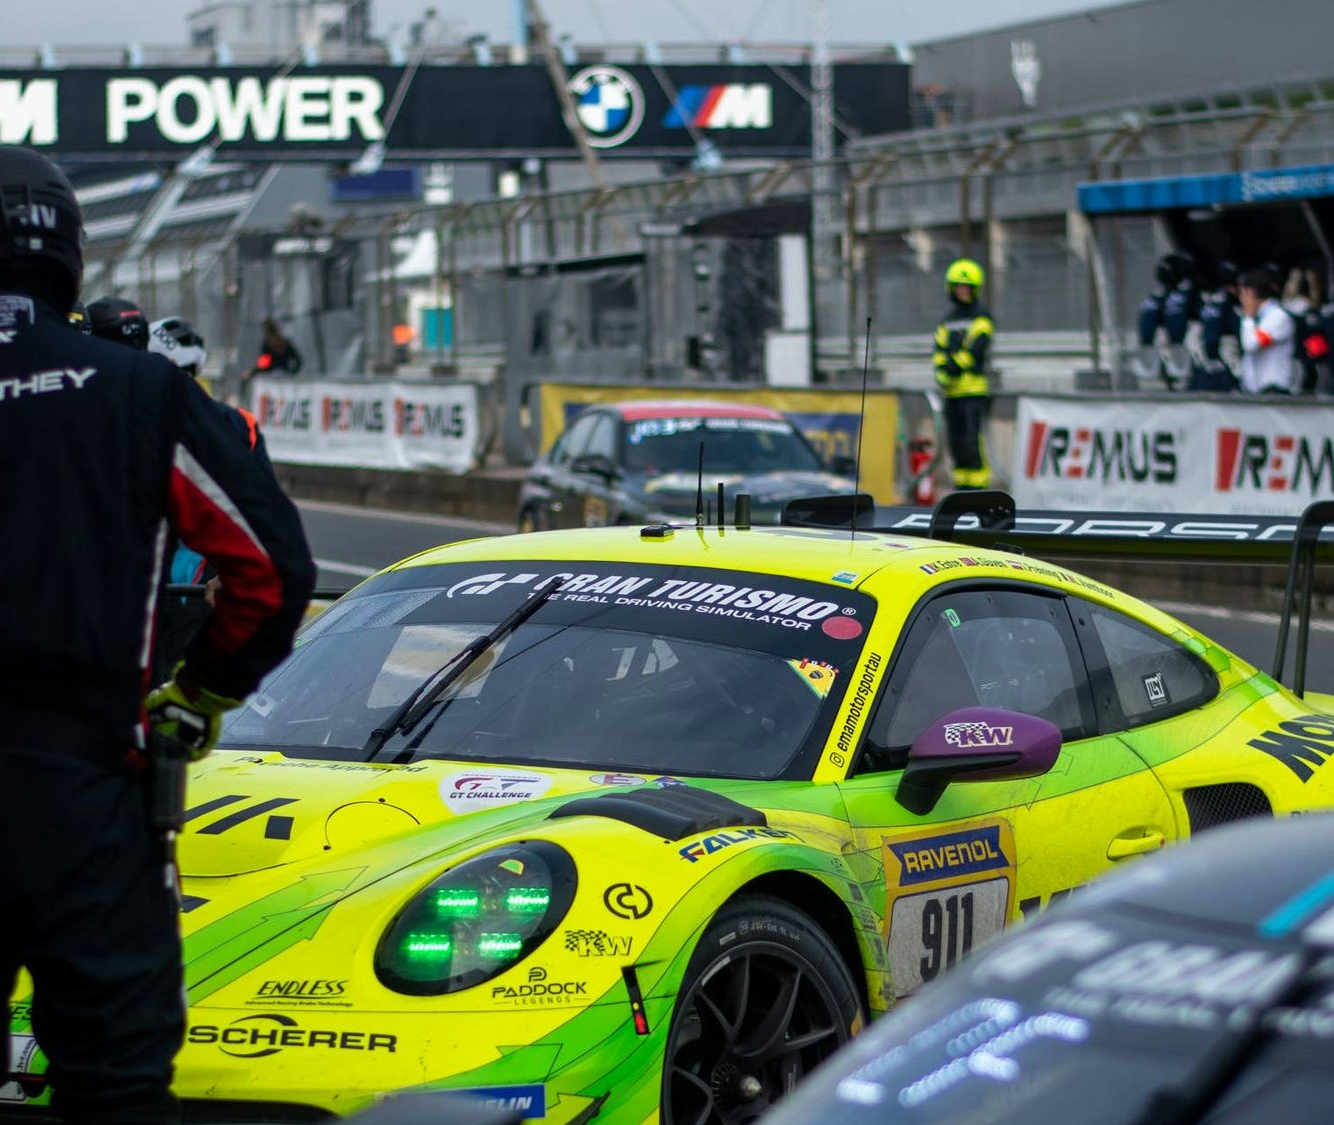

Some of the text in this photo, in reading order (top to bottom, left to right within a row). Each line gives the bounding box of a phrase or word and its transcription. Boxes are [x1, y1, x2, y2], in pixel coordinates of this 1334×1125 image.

[105, 74, 385, 143] POWER
[1025, 420, 1180, 487] REMUS
[527, 591, 813, 631] TE REAL DRIVING SIMULATOR
[653, 579, 840, 622] TURISMO
[837, 652, 882, 752] emamotorsportau
[957, 726, 1014, 748] KW
[449, 791, 533, 799] GT CHALLENGE
[903, 839, 999, 874] RAVENOL
[576, 933, 634, 958] KW
[919, 891, 974, 983] 911
[256, 979, 350, 996] ENDLESS
[492, 981, 587, 998] PADDOCK
[513, 995, 572, 1006] LEGENDS
[187, 1024, 398, 1053] SCHERER
